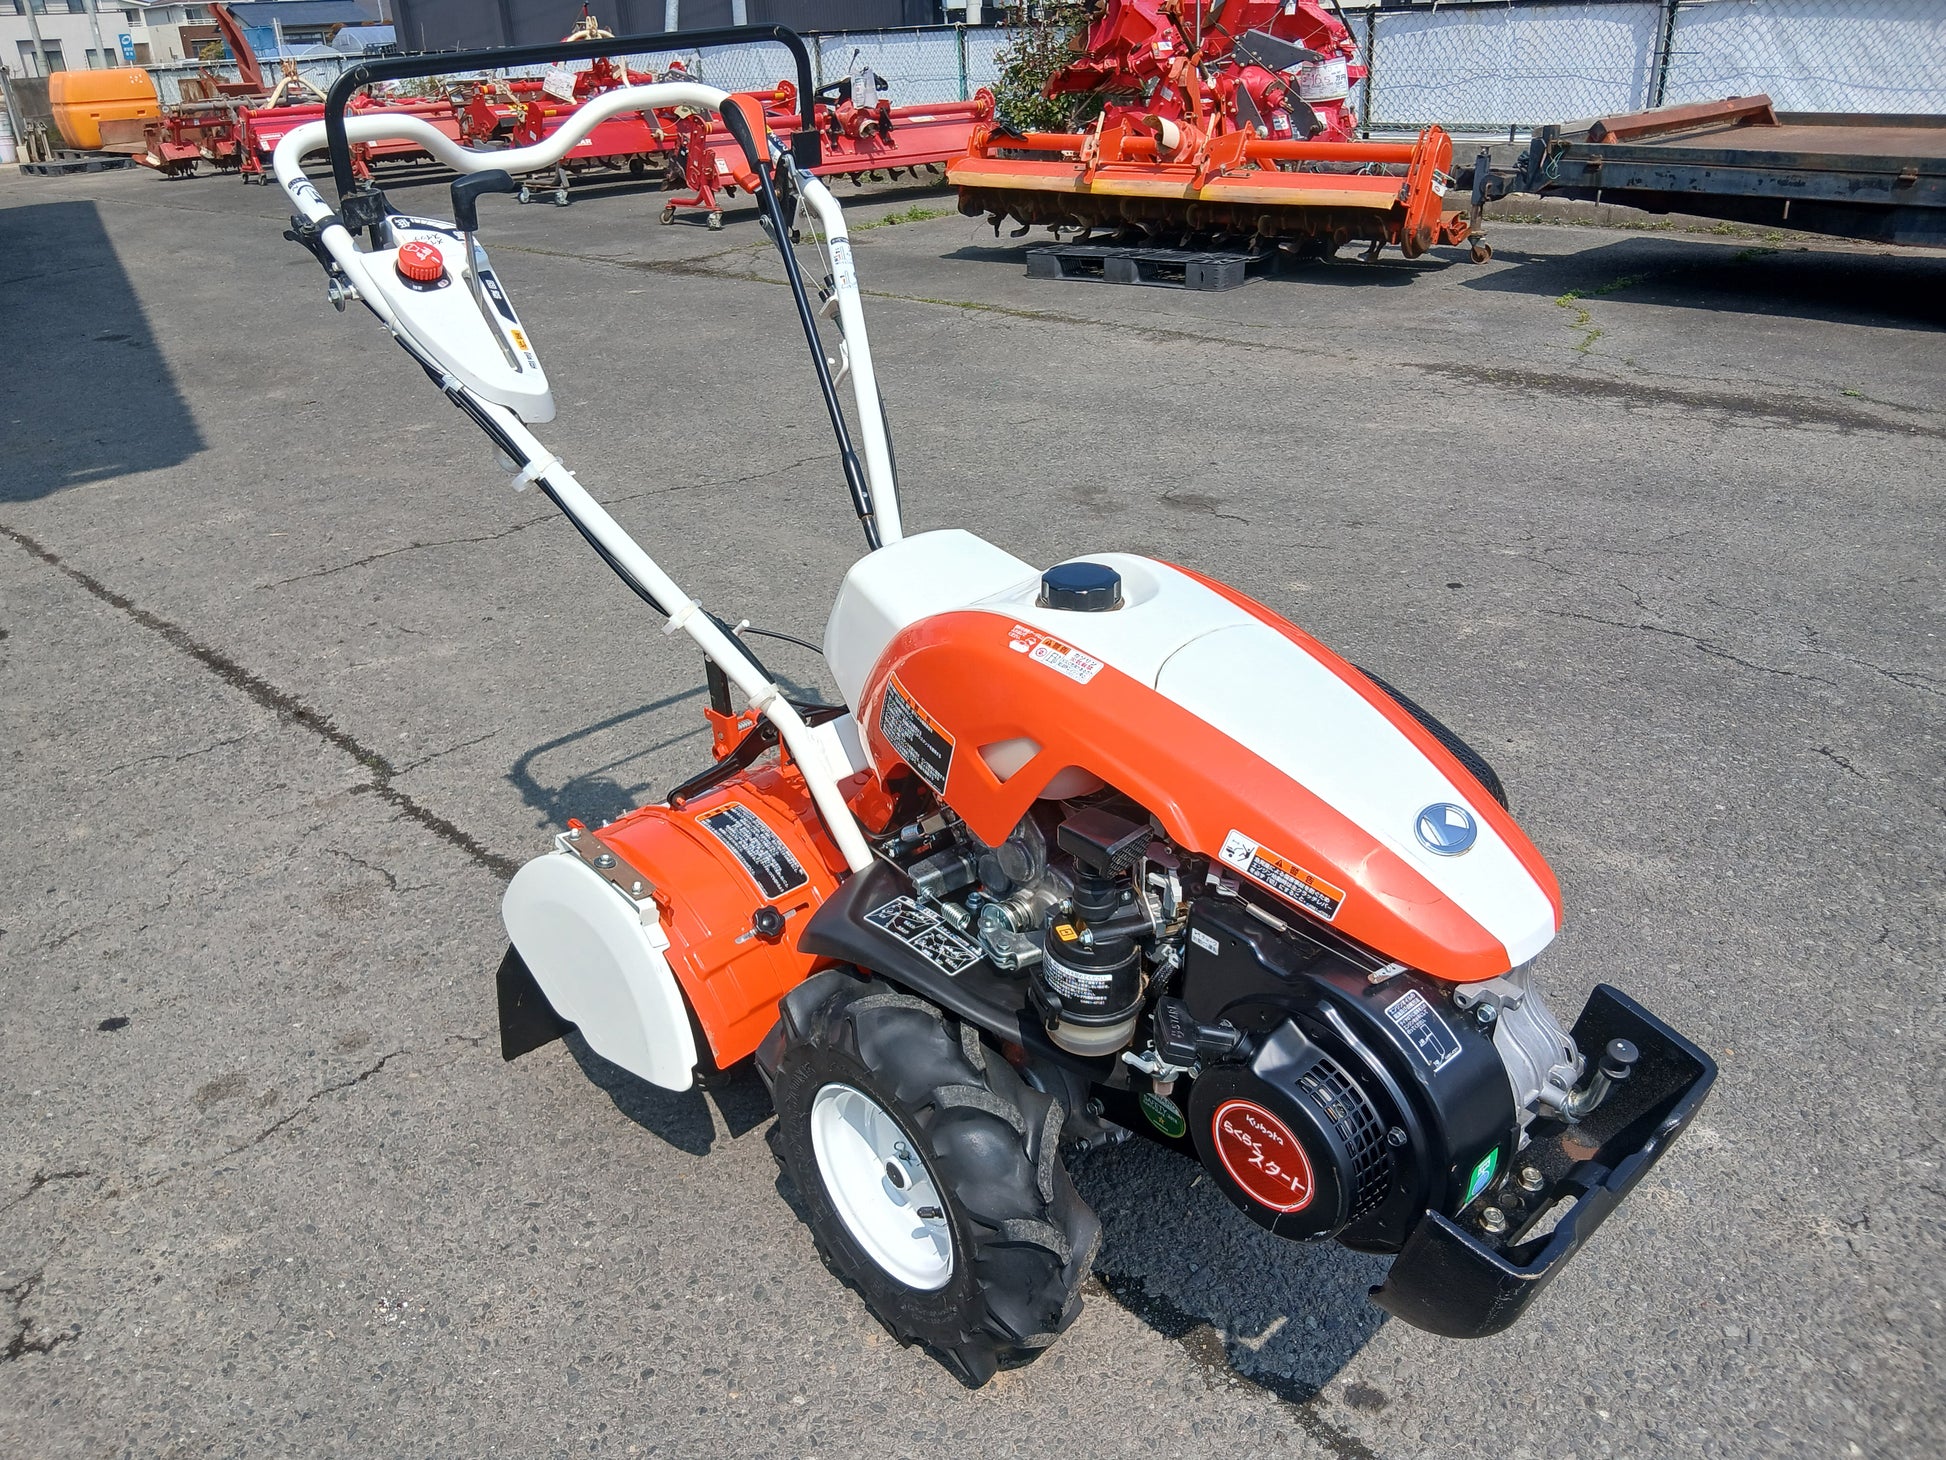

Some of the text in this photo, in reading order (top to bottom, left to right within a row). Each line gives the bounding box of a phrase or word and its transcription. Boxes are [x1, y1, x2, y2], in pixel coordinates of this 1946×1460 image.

[1223, 1120, 1262, 1154] らくらく
[1246, 1114, 1284, 1146] Kubota
[1247, 1149, 1306, 1191] スタート
